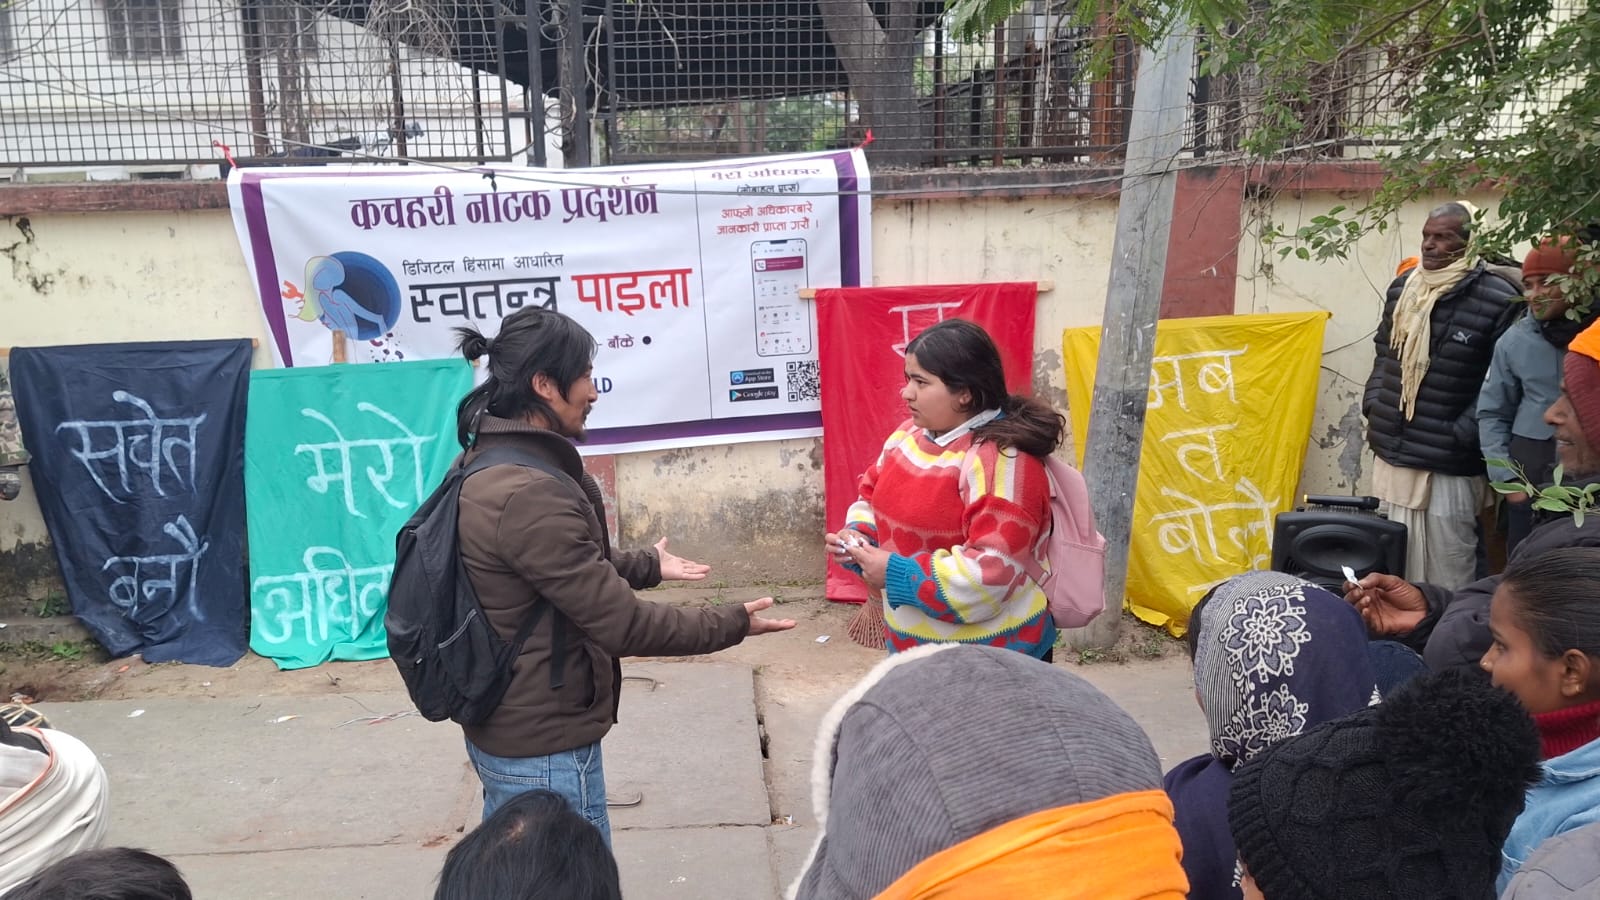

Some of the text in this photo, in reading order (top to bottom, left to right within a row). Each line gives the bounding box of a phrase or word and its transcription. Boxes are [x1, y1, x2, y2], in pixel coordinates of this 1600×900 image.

[349, 176, 658, 230] कचहरी नाटक प्रदर्शन
[717, 221, 759, 235] जानकारी
[757, 200, 813, 216] अधिकारबारे
[402, 252, 564, 276] डिजिटल हिंसामा आधारित
[409, 268, 692, 323] स्वतन्त्र पाइला
[607, 333, 634, 349] बाँके
[594, 377, 613, 394] LD
[1146, 345, 1248, 412] अब
[55, 390, 207, 504] सचेत
[294, 402, 437, 519] मेरो
[1159, 421, 1239, 483] त
